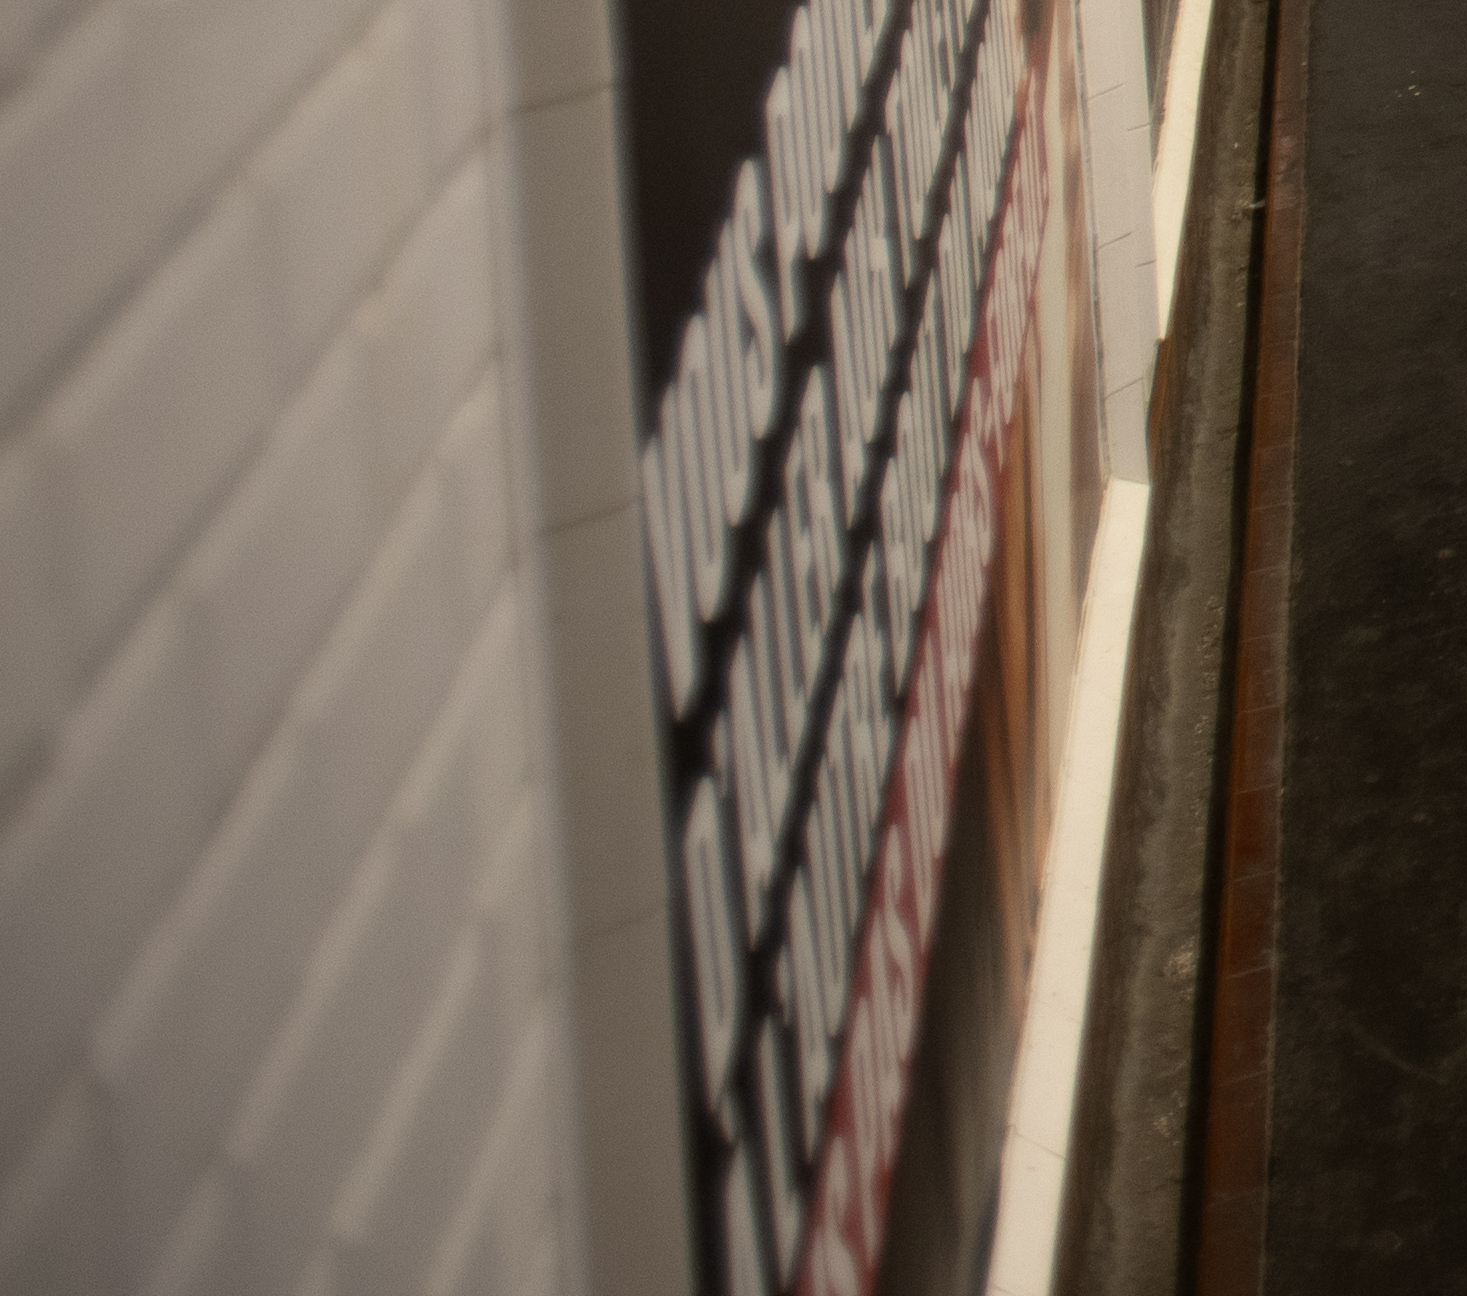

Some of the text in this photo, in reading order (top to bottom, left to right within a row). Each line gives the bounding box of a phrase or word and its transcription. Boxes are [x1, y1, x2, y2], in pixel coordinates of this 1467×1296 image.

[638, 150, 775, 720] VOUS
[683, 342, 839, 1129] D'ALLER
[828, 128, 897, 532] AUX
[880, 263, 948, 702] BOUT
[936, 147, 973, 420] DU
[848, 805, 915, 1275] PAS
[903, 612, 948, 963] DU
